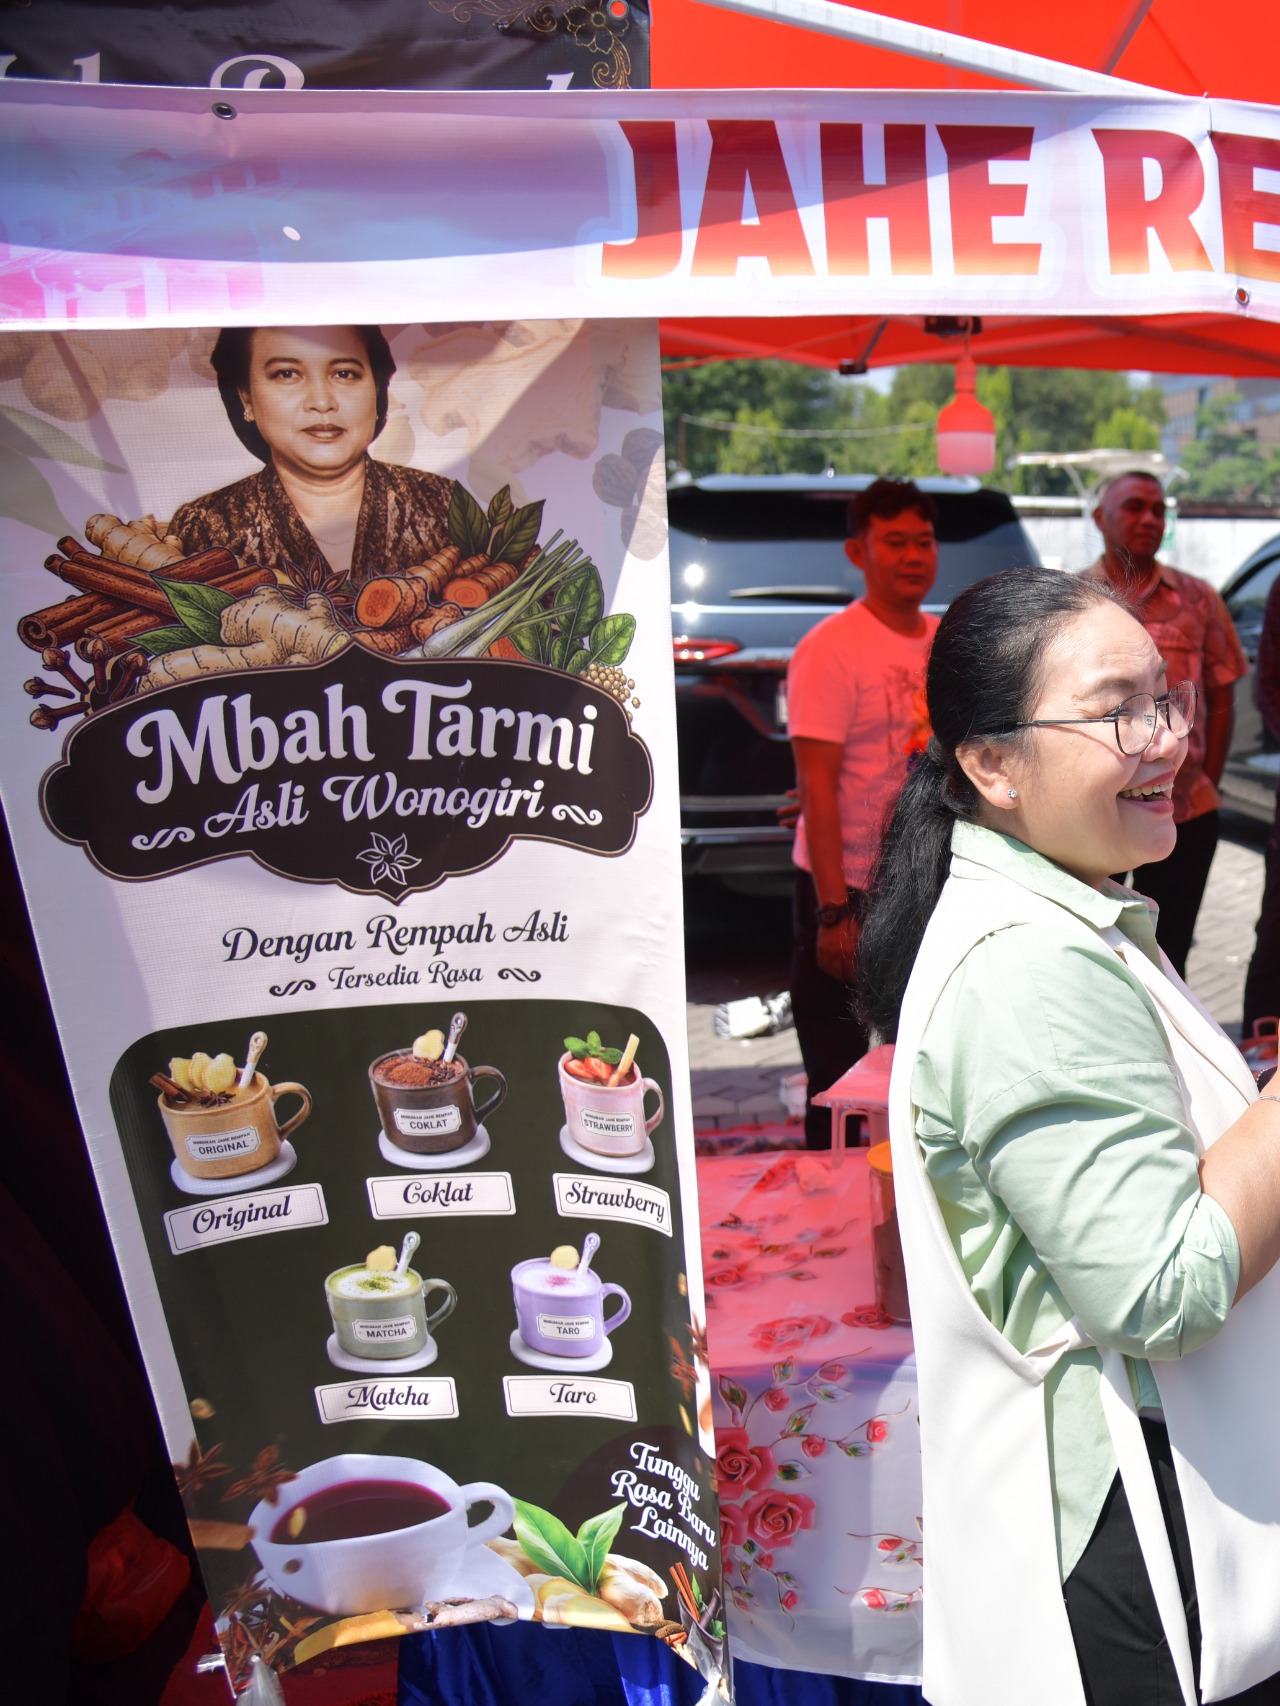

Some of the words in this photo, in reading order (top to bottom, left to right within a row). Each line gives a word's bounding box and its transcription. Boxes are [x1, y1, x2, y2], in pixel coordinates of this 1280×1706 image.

[600, 119, 1046, 280] JAHE
[125, 683, 376, 805] Mbah
[381, 679, 600, 775] Tarmi
[203, 780, 310, 840] Asli
[321, 772, 546, 830] Wonogiri
[221, 927, 356, 964] Dengan
[365, 912, 496, 957] Rempah
[502, 910, 571, 945] Asli
[327, 965, 423, 991] Tersedia
[427, 963, 484, 987] Rasa
[409, 1119, 448, 1130] COKLAT
[583, 1118, 633, 1132] STRAWBERRY
[198, 1140, 250, 1155] ORIGINAL
[402, 1181, 474, 1206] Coklat
[564, 1181, 667, 1225] Strawberry
[192, 1195, 293, 1235] Original
[366, 1327, 407, 1338] MATCHA
[556, 1326, 580, 1335] TARO
[346, 1384, 432, 1408] Matcha
[548, 1382, 599, 1406] Taro
[629, 1441, 701, 1502] Tunggu
[610, 1469, 674, 1511] Rasa
[677, 1492, 717, 1548] Baru
[629, 1506, 709, 1571] Lainnya
